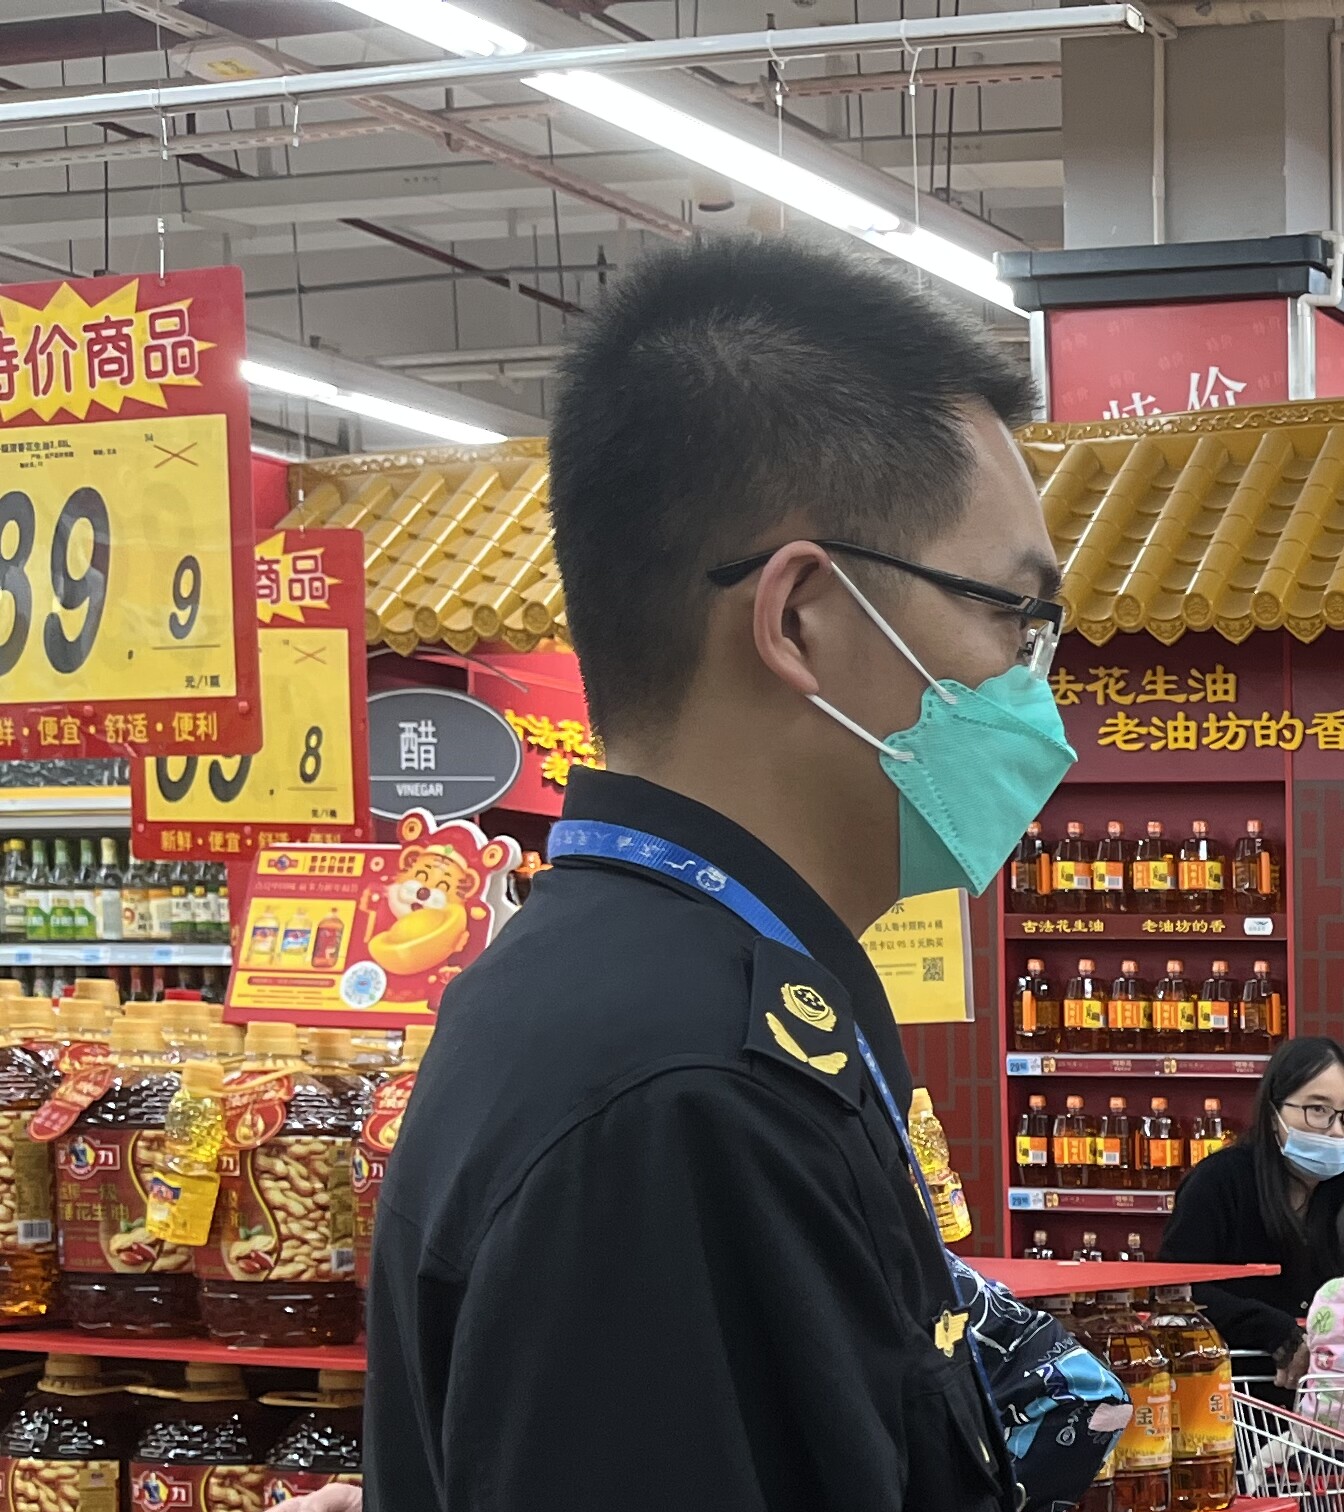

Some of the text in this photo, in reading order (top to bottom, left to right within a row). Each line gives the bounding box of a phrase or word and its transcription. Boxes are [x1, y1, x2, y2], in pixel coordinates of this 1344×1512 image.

[398, 720, 438, 770] 醋
[396, 783, 444, 797] VINEGAR
[1021, 919, 1226, 934] 古法花生油 老油坊的香
